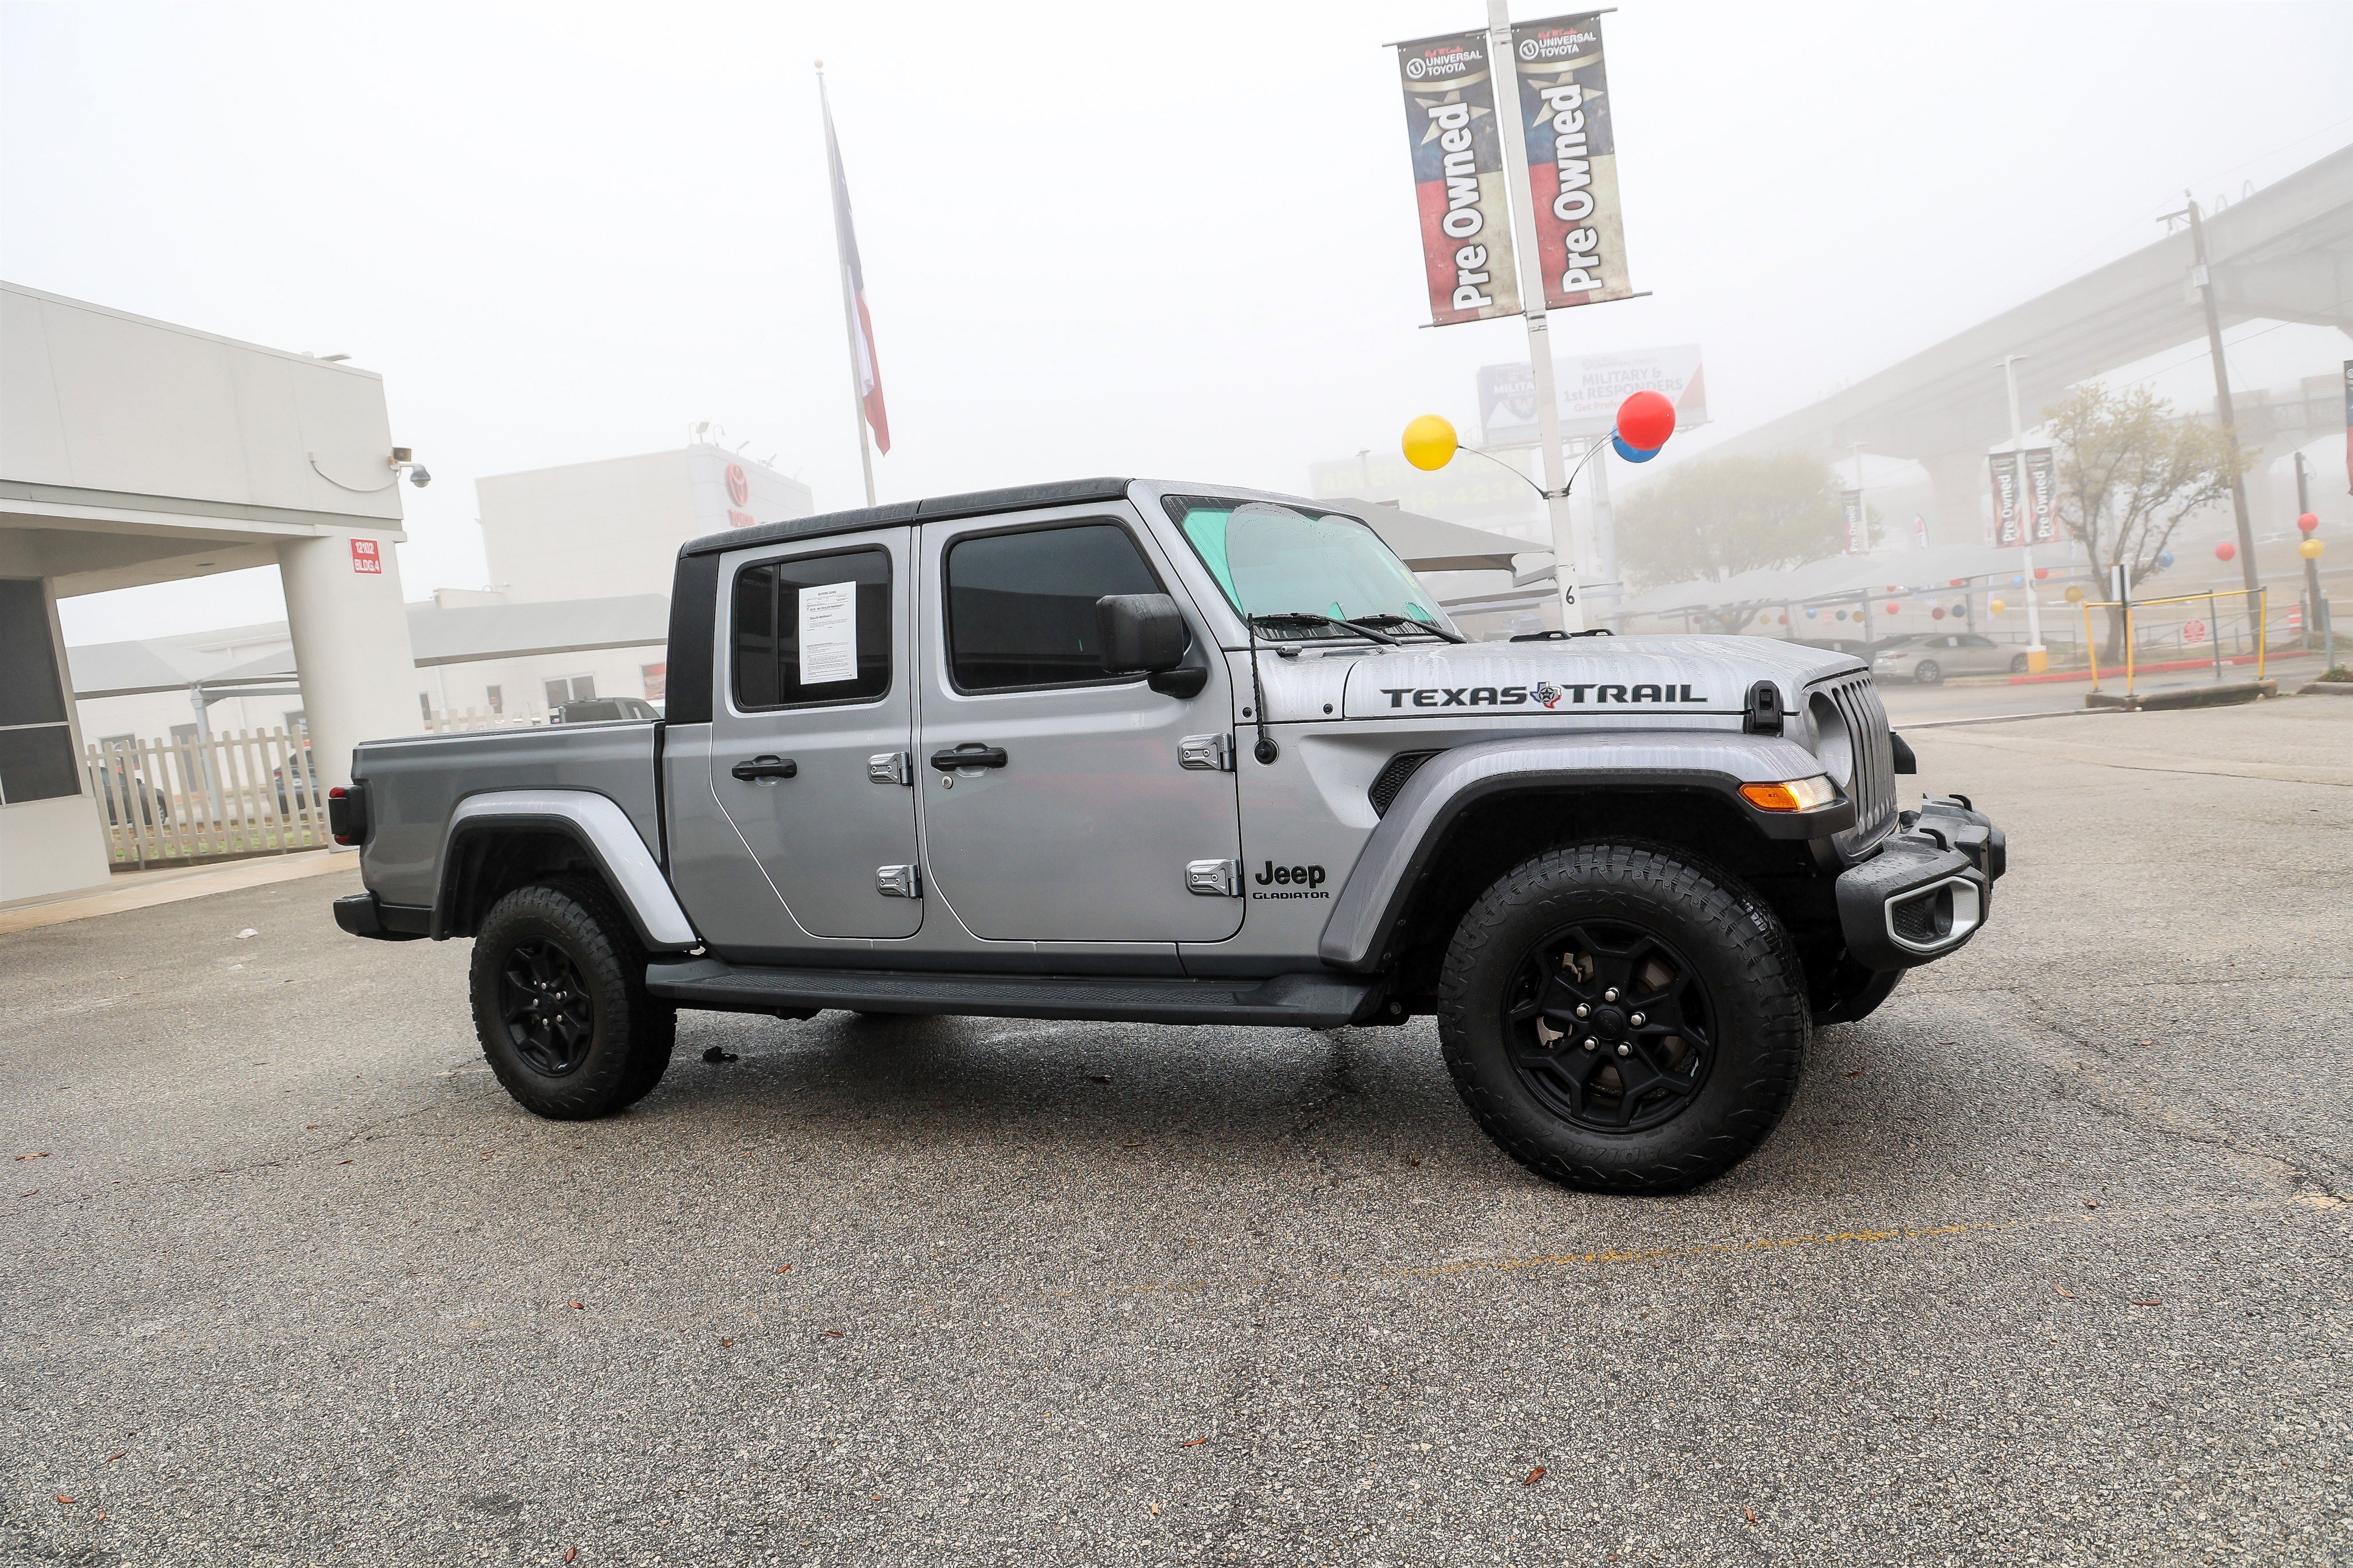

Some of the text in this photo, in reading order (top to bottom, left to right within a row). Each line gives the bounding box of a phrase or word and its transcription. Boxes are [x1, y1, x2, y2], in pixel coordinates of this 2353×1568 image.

[1539, 31, 1596, 48] UNIVERSAL
[1426, 49, 1483, 67] UNIVERSAL
[1540, 44, 1579, 58] TOYOTA
[1426, 62, 1467, 76] TOYOTA
[1540, 83, 1603, 293] Pre Owned
[1428, 102, 1493, 311] Pre Owned
[1494, 380, 1536, 395] MILITA
[1582, 369, 1649, 386] MILITARY
[1563, 389, 1584, 402] 1st
[1998, 474, 2014, 518] Owned
[2032, 470, 2049, 514] Owned
[2003, 520, 2016, 541] Pre
[2038, 517, 2052, 538] Pre
[354, 541, 375, 555] 12102
[1566, 585, 1575, 605] 6
[1380, 683, 1708, 708] TEXAS TRAIL
[1255, 860, 1326, 889] Jeep
